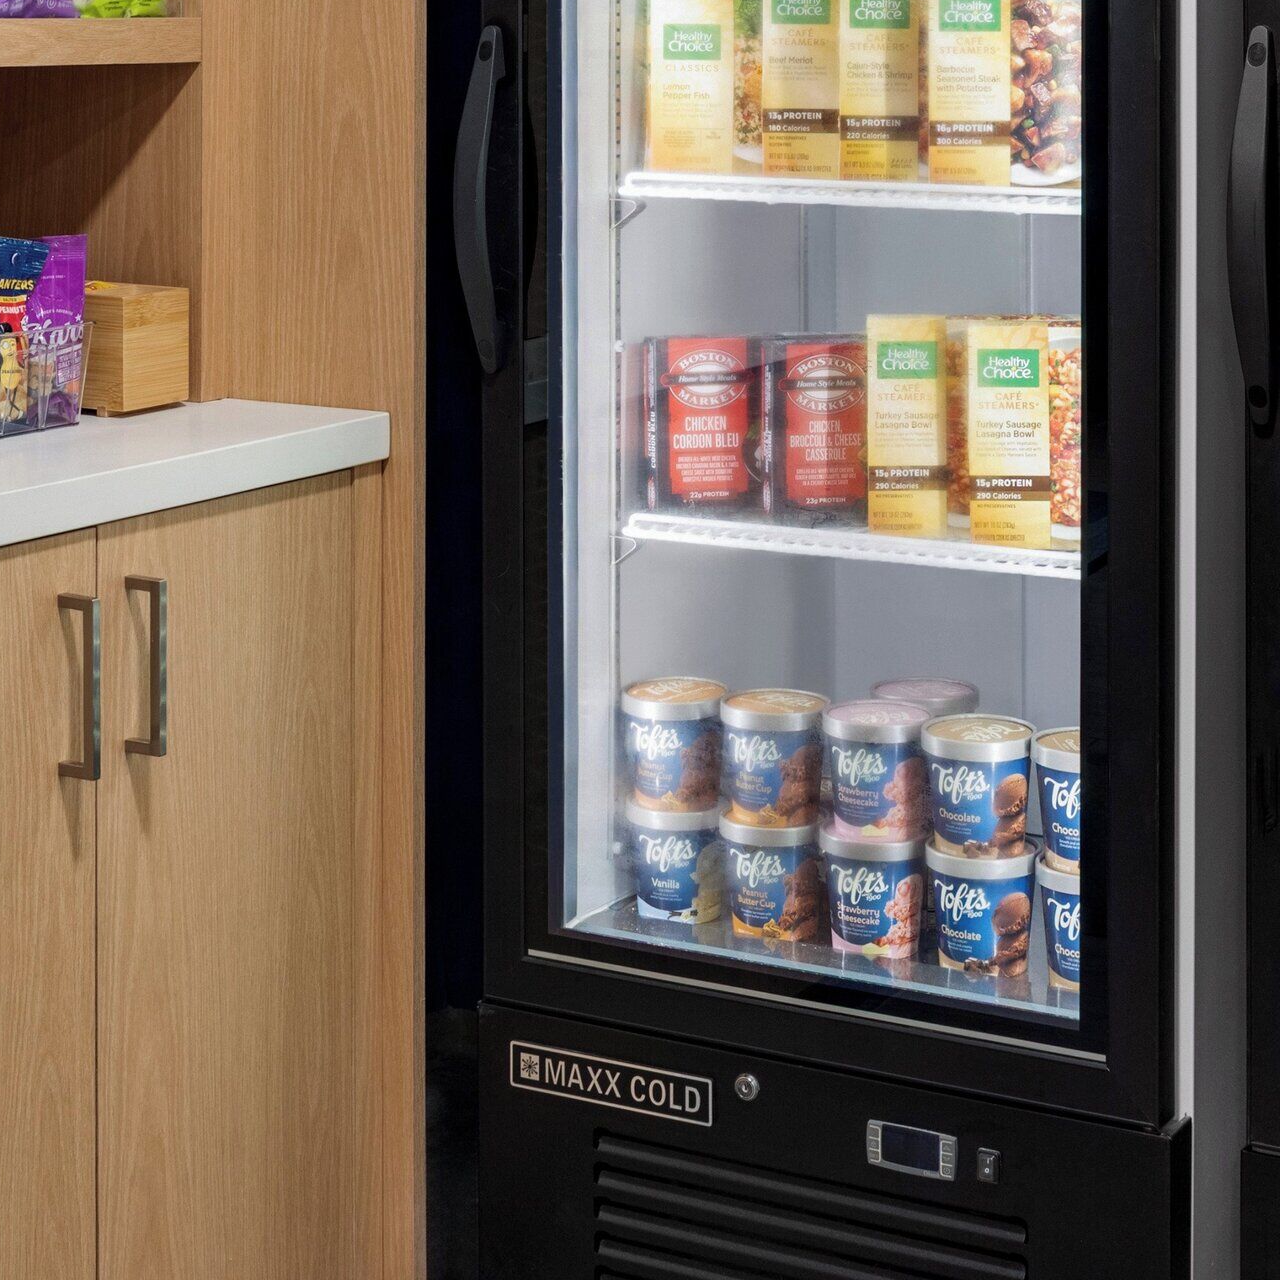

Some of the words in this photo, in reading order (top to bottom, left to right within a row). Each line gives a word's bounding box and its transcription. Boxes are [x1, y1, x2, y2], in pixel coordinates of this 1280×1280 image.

[777, 4, 822, 16] Choice
[951, 0, 992, 12] Healthy
[855, 8, 902, 20] Choice
[944, 11, 993, 23] Choice
[673, 31, 713, 44] Healthy
[668, 40, 713, 53] Choice
[937, 124, 951, 133] 16g
[679, 353, 737, 369] BOSTON
[888, 349, 928, 360] Healthy
[797, 358, 855, 374] BOSTON
[882, 358, 929, 370] Choice
[989, 357, 1030, 368] Healthy
[983, 366, 1032, 379] Choice
[678, 388, 736, 406] MARKET
[796, 395, 855, 411] MARKET
[685, 416, 726, 431] CHICKEN
[875, 413, 902, 421] Turkey
[977, 421, 1003, 430] Turkey
[1006, 421, 1042, 430] Sausage
[673, 434, 712, 448] CORDON
[716, 433, 738, 447] BLEU
[806, 448, 846, 461] CASSEROLE
[631, 722, 682, 756] Toft's
[729, 733, 781, 766] Toft's
[832, 745, 887, 786] Toft's
[932, 765, 988, 804] Toft's
[939, 807, 981, 823] Chocolate
[640, 834, 695, 872] Toft's
[731, 847, 785, 887] Toft's
[831, 866, 888, 906] Toft's
[934, 882, 989, 921] Toft's
[941, 925, 982, 941] Chocolate
[544, 1057, 621, 1099] MAXX
[630, 1075, 701, 1113] COLD
